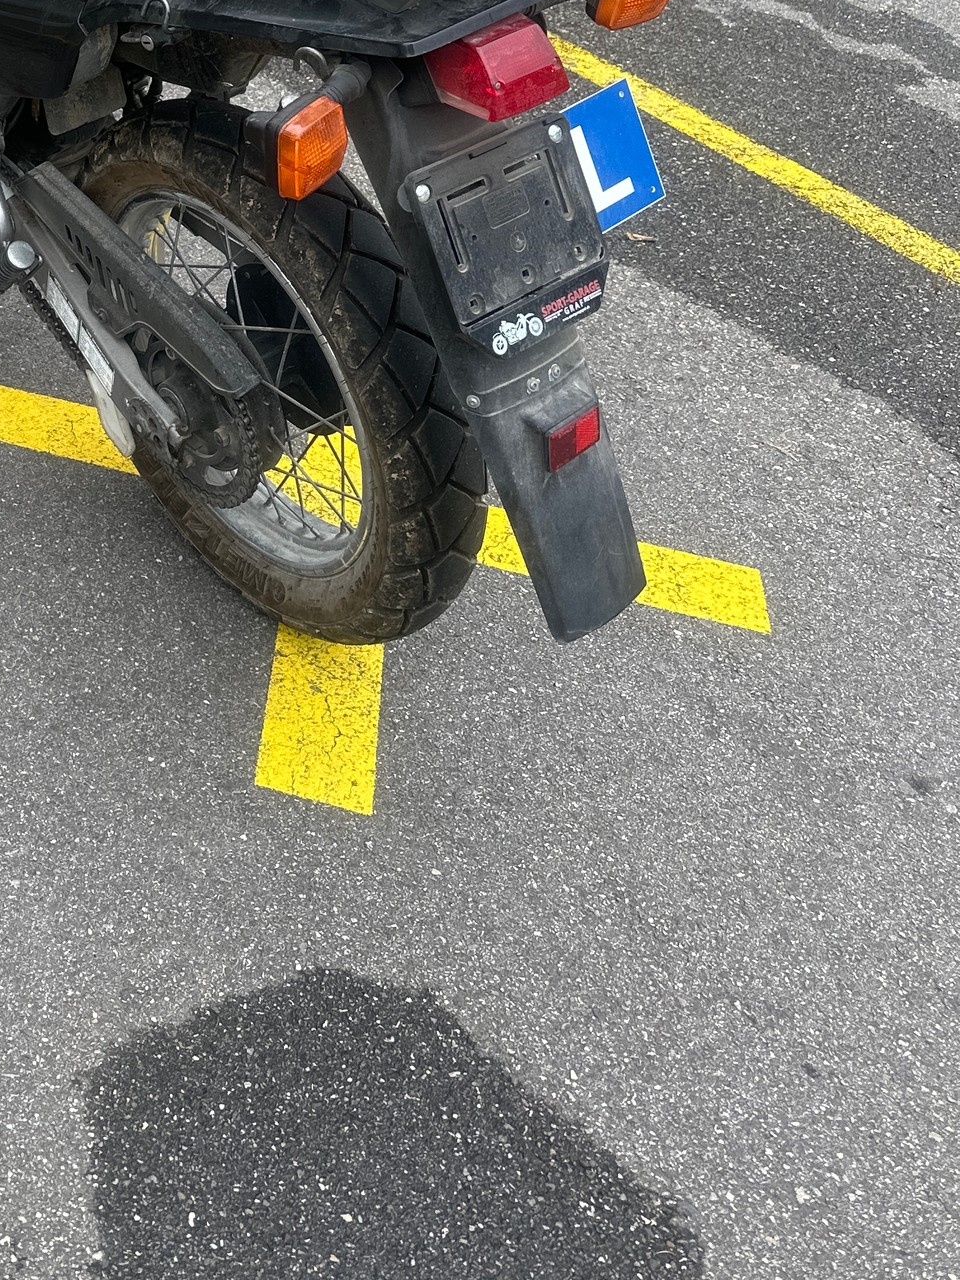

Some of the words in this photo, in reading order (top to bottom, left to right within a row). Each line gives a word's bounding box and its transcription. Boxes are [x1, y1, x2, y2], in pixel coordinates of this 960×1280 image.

[570, 125, 635, 213] L
[541, 279, 601, 317] SPORT-GARAGE
[563, 299, 585, 315] GRAF
